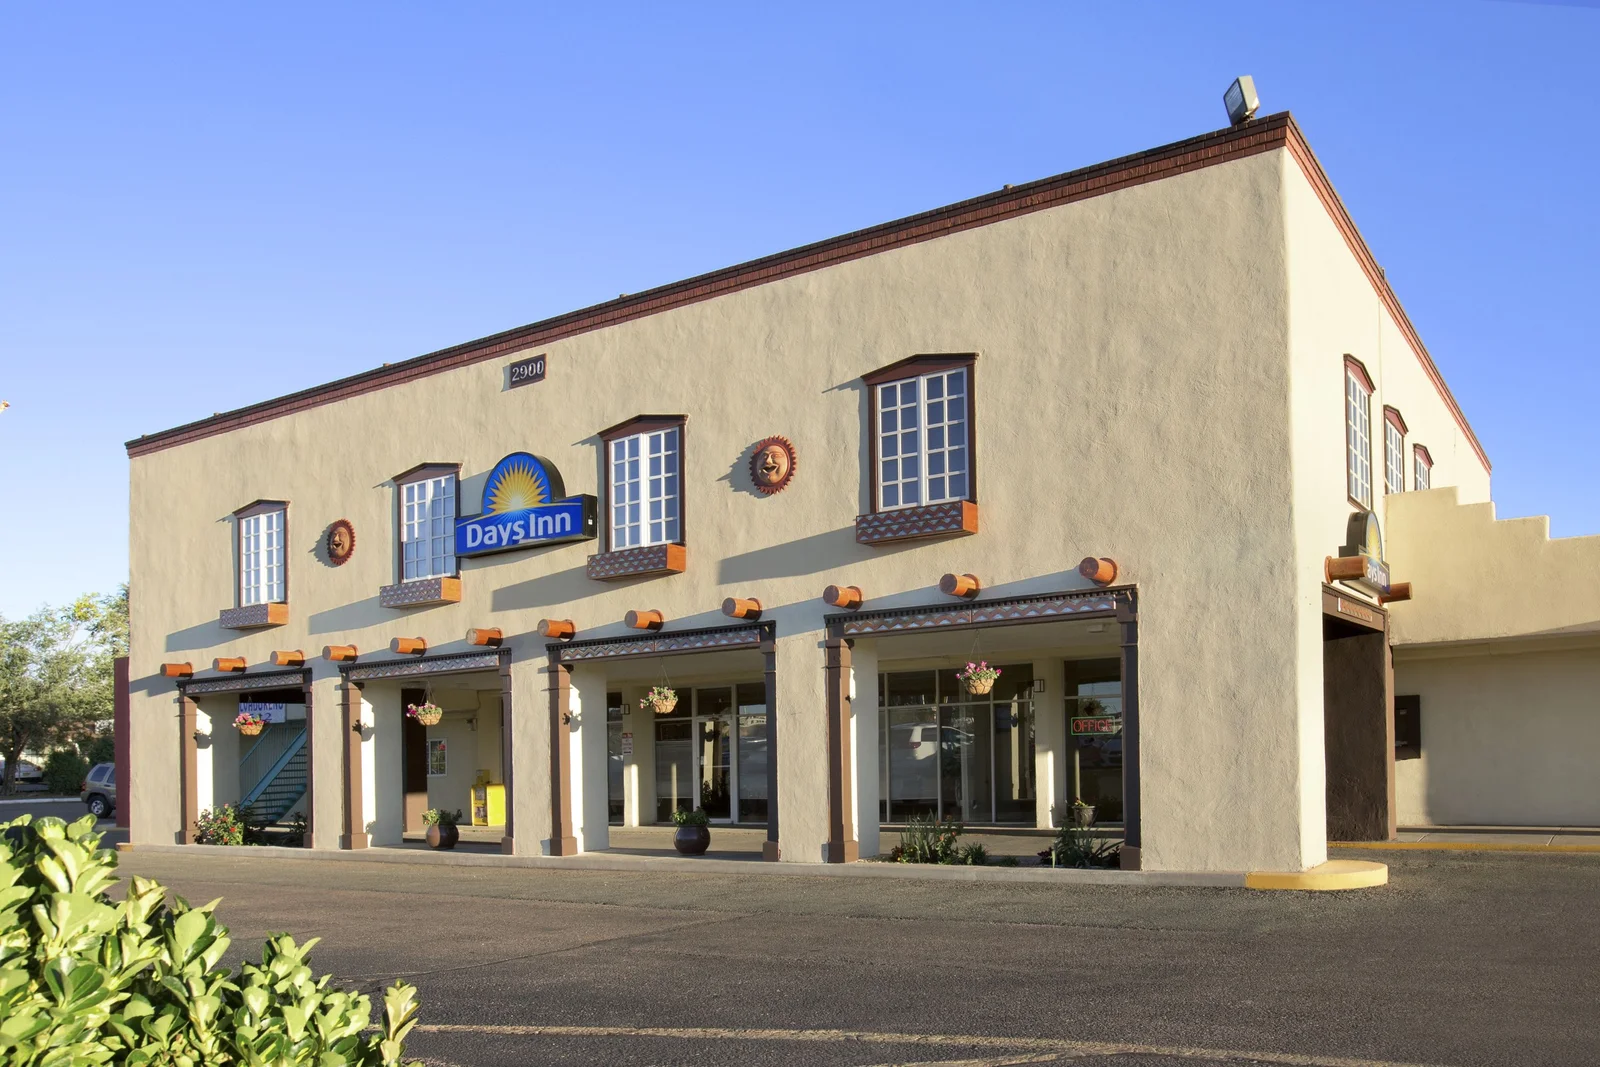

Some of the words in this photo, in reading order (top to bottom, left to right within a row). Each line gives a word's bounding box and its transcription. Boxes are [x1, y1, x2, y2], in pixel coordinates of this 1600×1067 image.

[512, 360, 544, 381] 2900
[466, 520, 525, 548] Days
[529, 512, 571, 537] Inn
[1367, 563, 1377, 583] ays
[1073, 719, 1113, 732] OFFICE
